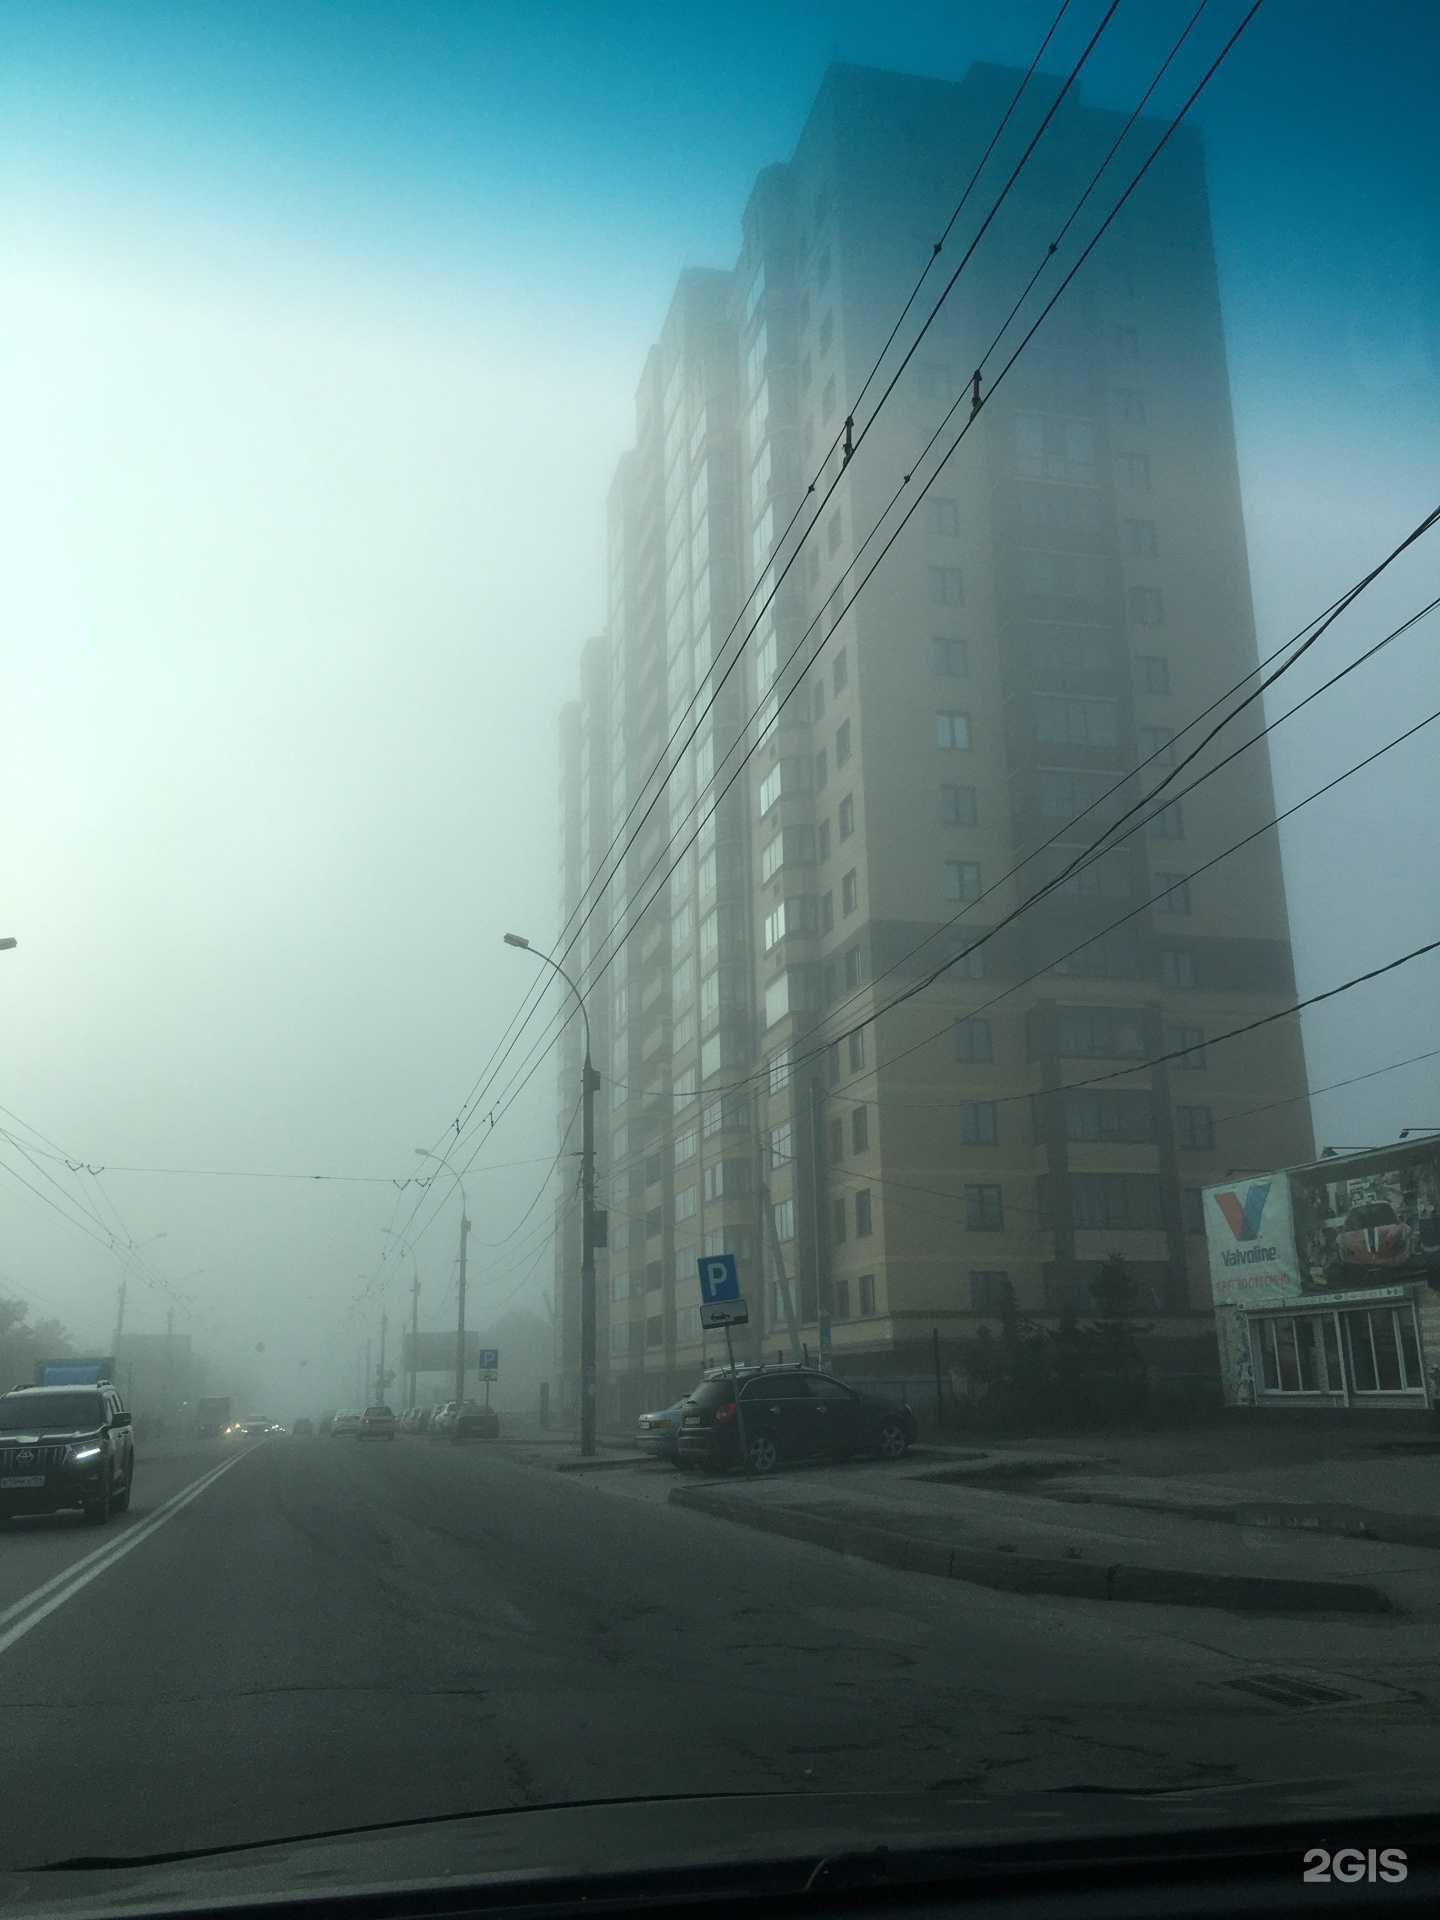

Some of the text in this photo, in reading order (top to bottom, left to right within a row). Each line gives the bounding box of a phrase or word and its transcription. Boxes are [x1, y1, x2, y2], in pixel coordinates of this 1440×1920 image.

[1222, 1246, 1278, 1267] Valvoline
[707, 1263, 728, 1297] P
[484, 1351, 496, 1367] P
